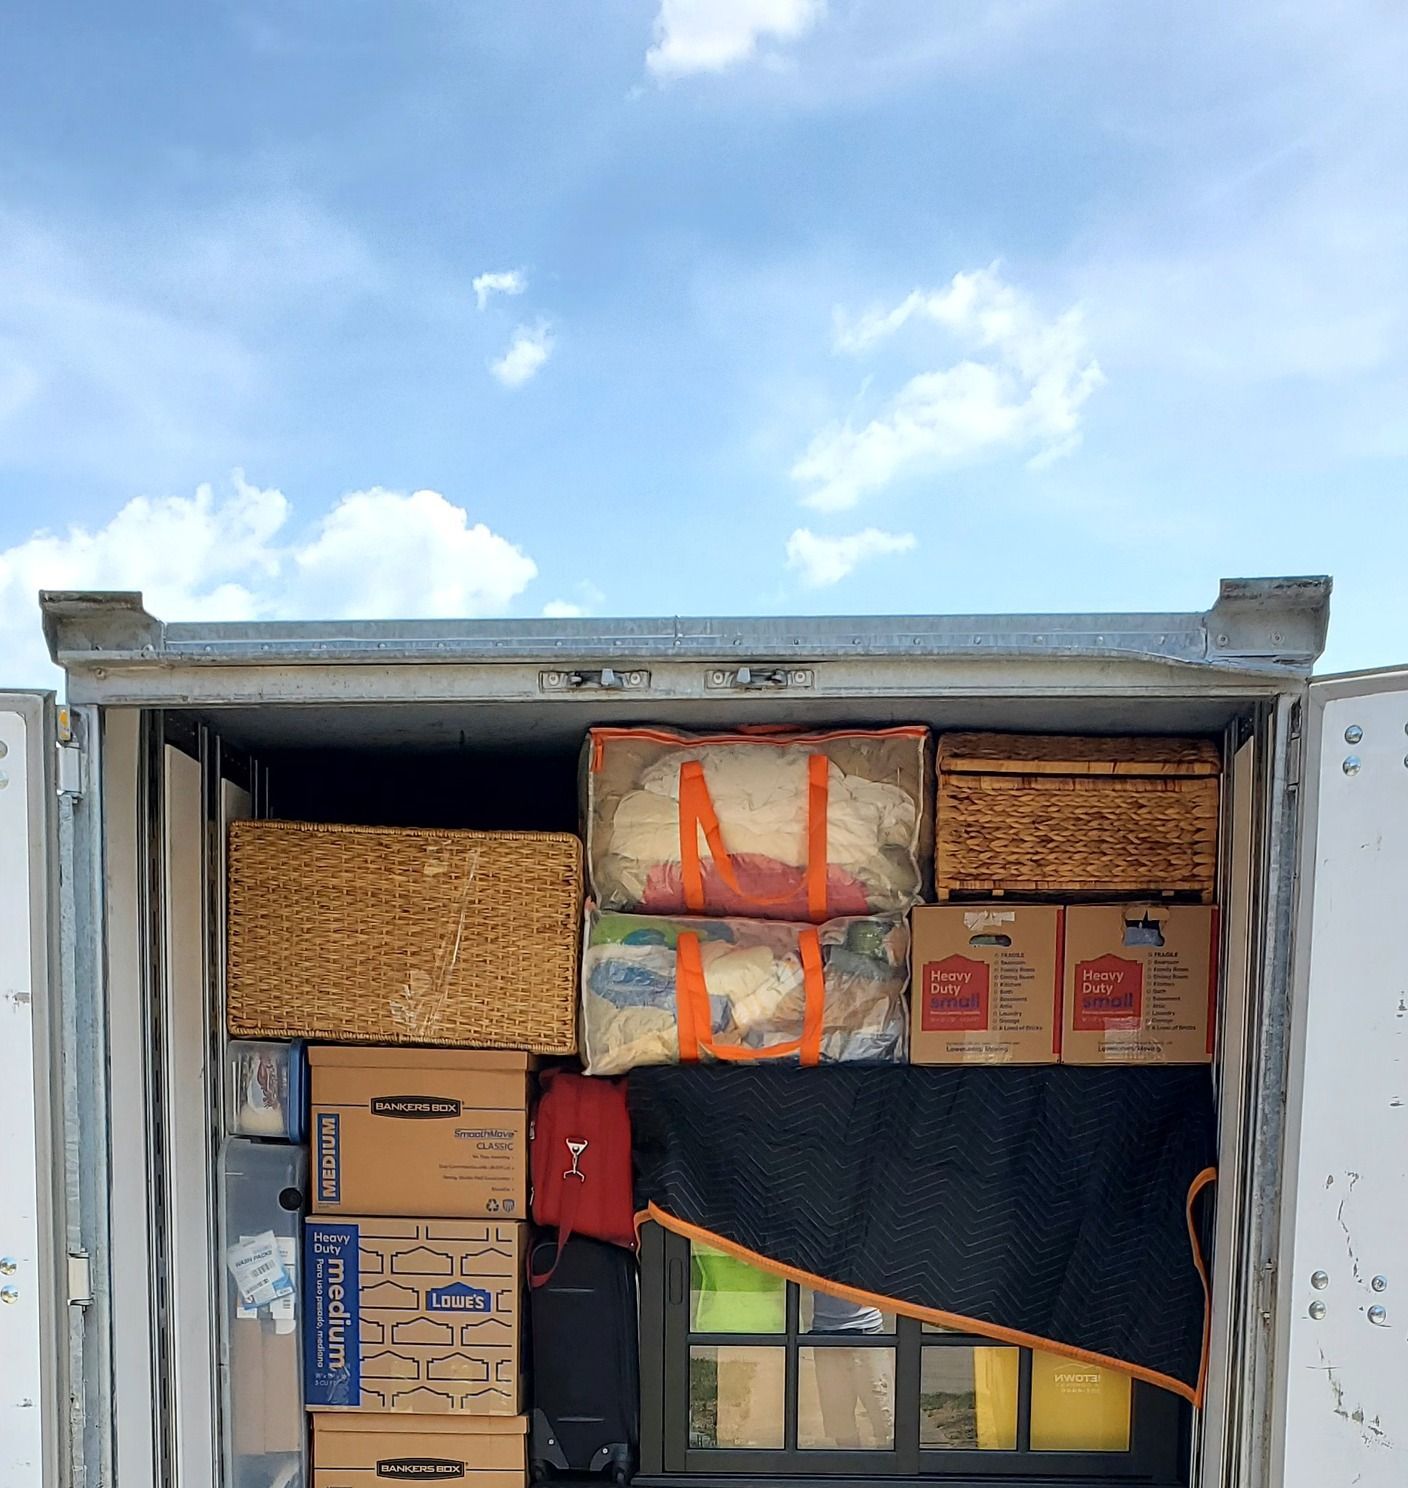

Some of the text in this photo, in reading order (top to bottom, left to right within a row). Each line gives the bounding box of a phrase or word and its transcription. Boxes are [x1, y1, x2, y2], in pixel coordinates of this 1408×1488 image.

[931, 970, 971, 983] Heavy
[1083, 969, 1124, 983] Heavy
[931, 983, 961, 996] Duty
[1083, 982, 1113, 995] Duty
[931, 994, 979, 1009] small
[1083, 992, 1133, 1008] small
[375, 1102, 457, 1112] BANKERS BOX
[476, 1142, 514, 1151] CLASSIC
[322, 1117, 337, 1197] MEDIUM
[313, 1232, 350, 1245] Heavy
[313, 1243, 341, 1255] Duty
[316, 1279, 324, 1295] uso
[432, 1292, 485, 1309] LOWE'S
[328, 1258, 351, 1370] medium
[381, 1465, 460, 1473] BANKERS BOX
